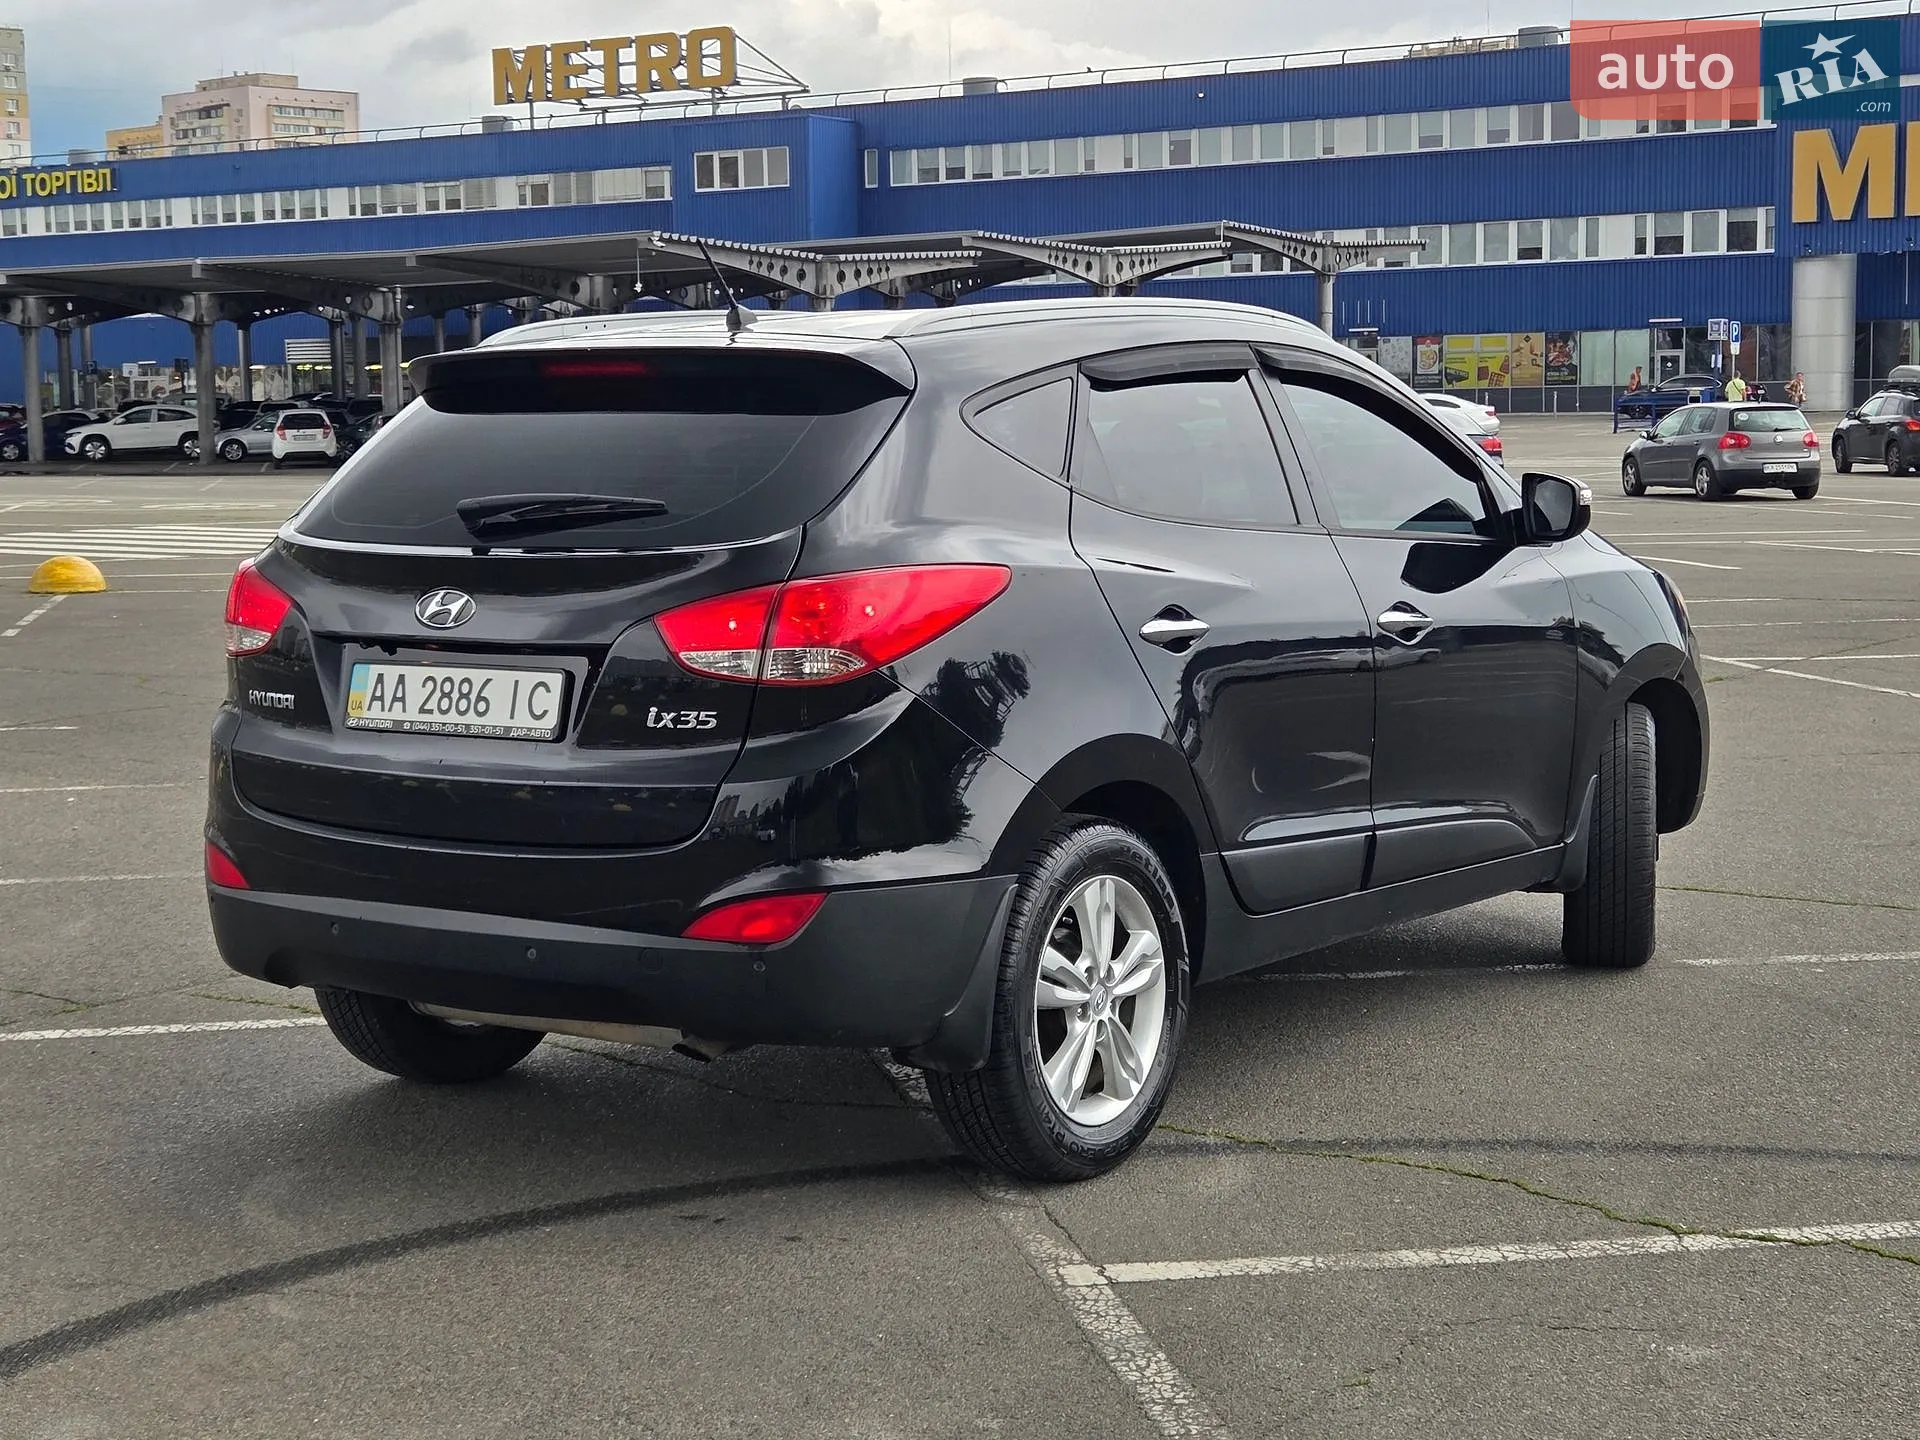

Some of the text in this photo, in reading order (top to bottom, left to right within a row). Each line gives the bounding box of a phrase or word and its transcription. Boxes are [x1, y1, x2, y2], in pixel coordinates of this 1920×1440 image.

[492, 26, 737, 105] METRO
[1792, 121, 1920, 223] M
[249, 690, 295, 710] HYUNDAI
[351, 700, 363, 712] UA
[418, 676, 494, 718] 2886
[358, 719, 394, 729] HYUNDAI
[469, 725, 504, 735] 351-01-51
[510, 728, 551, 738] ДАР-АВТО
[646, 707, 718, 729] ix35
